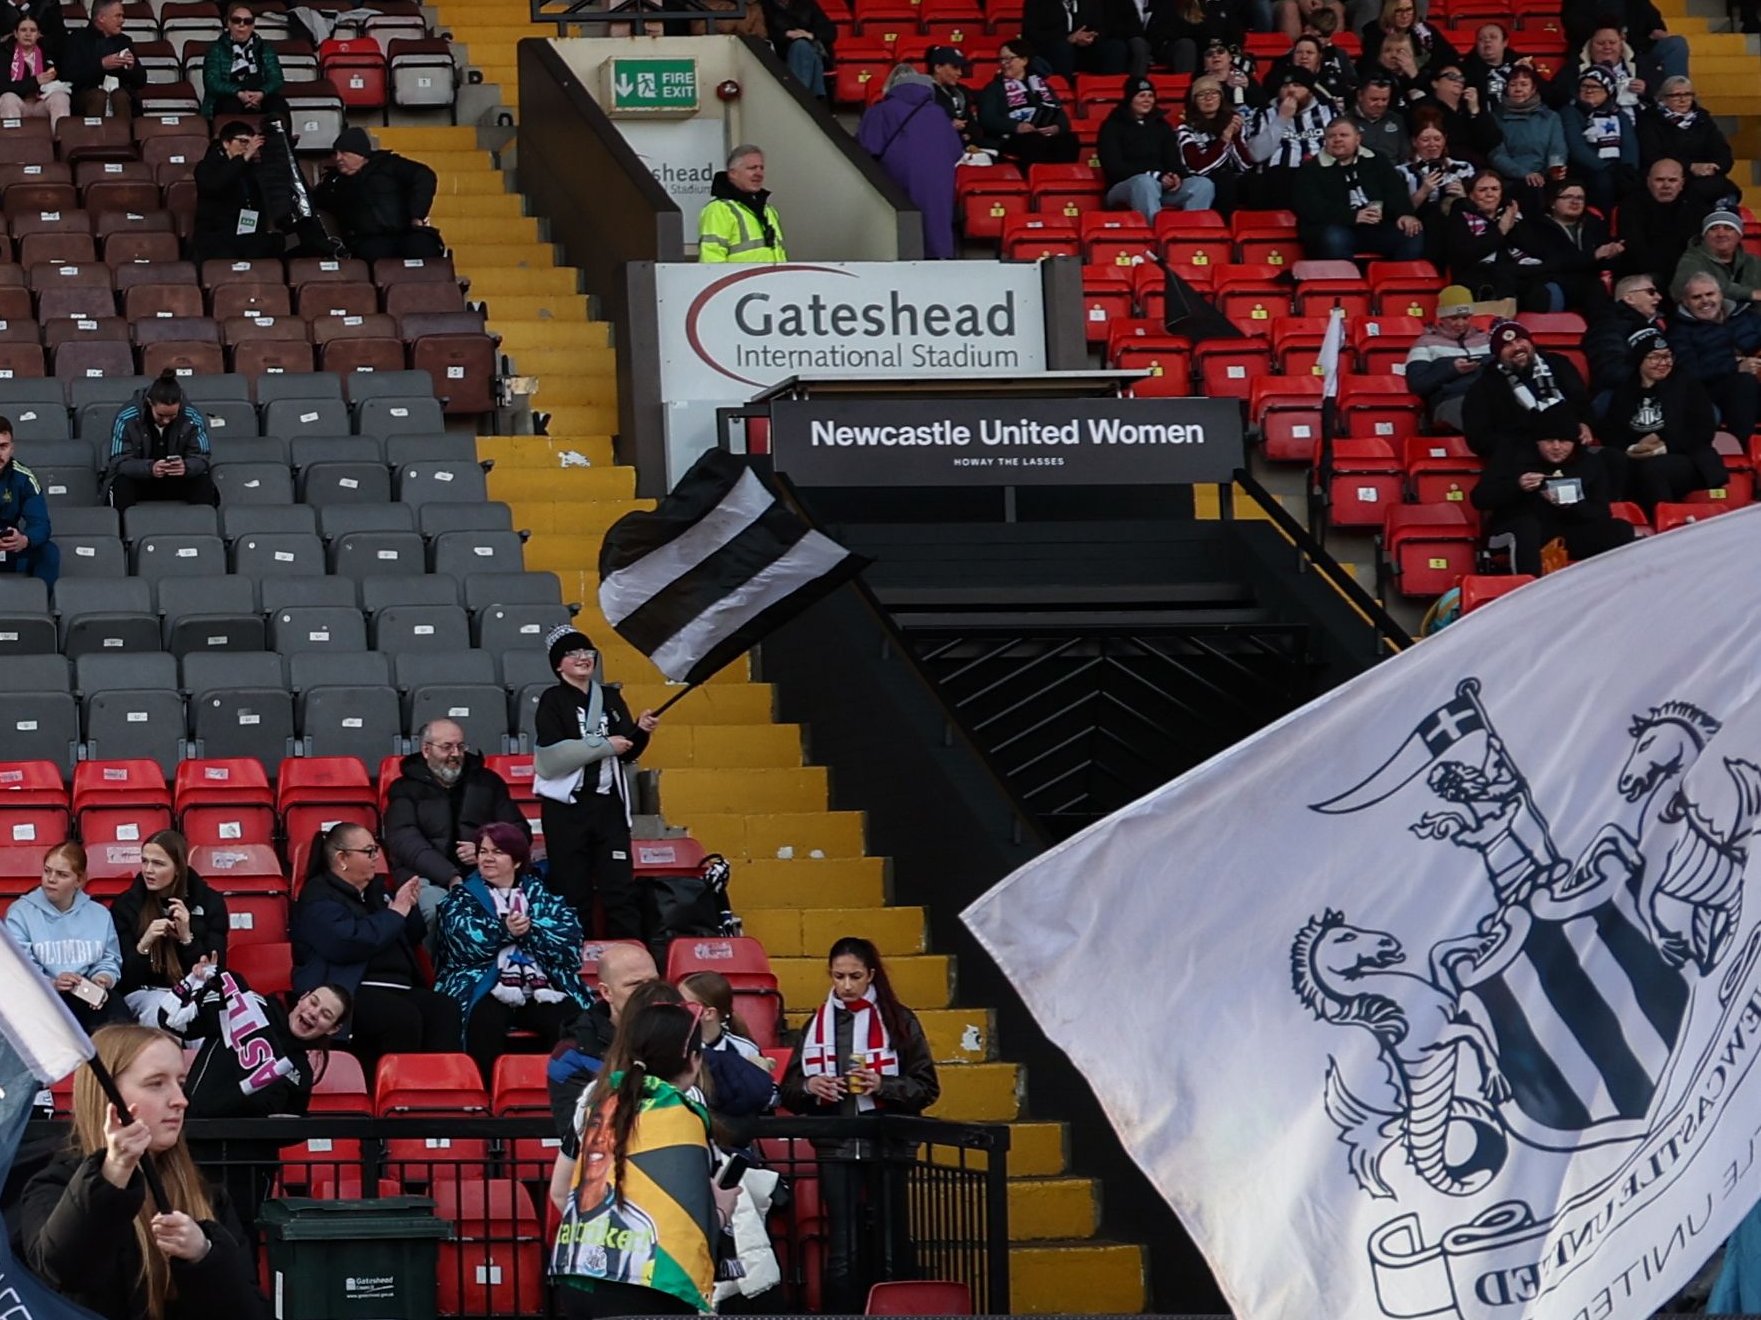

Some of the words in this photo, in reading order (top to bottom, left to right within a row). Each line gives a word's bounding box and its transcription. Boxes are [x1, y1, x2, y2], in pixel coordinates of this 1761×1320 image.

[661, 72, 695, 84] FIRE
[662, 85, 695, 98] EXIT
[651, 163, 713, 182] shead
[734, 290, 1016, 338] Gateshead
[735, 343, 903, 370] International
[911, 342, 1018, 369] Stadium
[811, 419, 971, 447] Newcastle
[979, 419, 1080, 447] United
[1088, 418, 1206, 446] Women
[953, 457, 994, 467] HOWAY
[997, 457, 1022, 467] THE
[1024, 456, 1066, 467] LASSES
